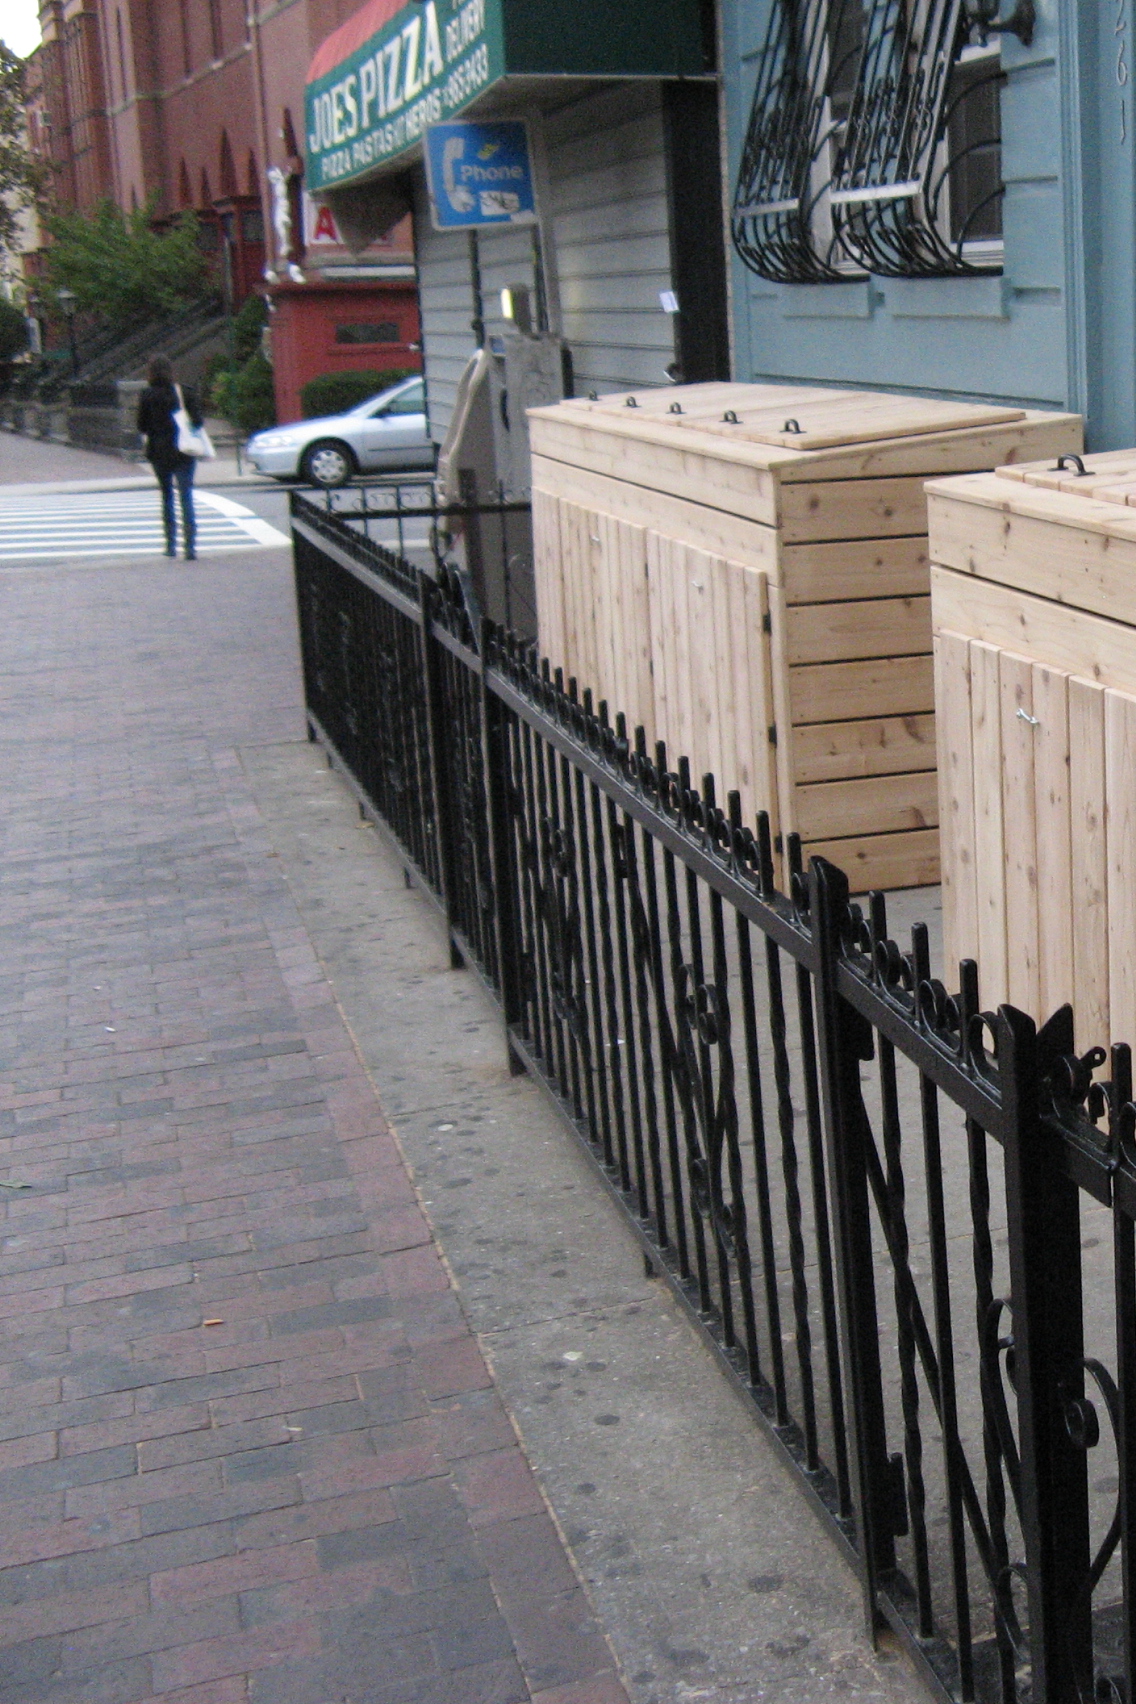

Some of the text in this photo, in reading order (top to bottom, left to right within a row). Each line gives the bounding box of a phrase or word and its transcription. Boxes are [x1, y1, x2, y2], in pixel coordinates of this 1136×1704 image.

[360, 0, 444, 129] PIZZA
[321, 148, 351, 180] PIZZA
[460, 164, 524, 182] Phone
